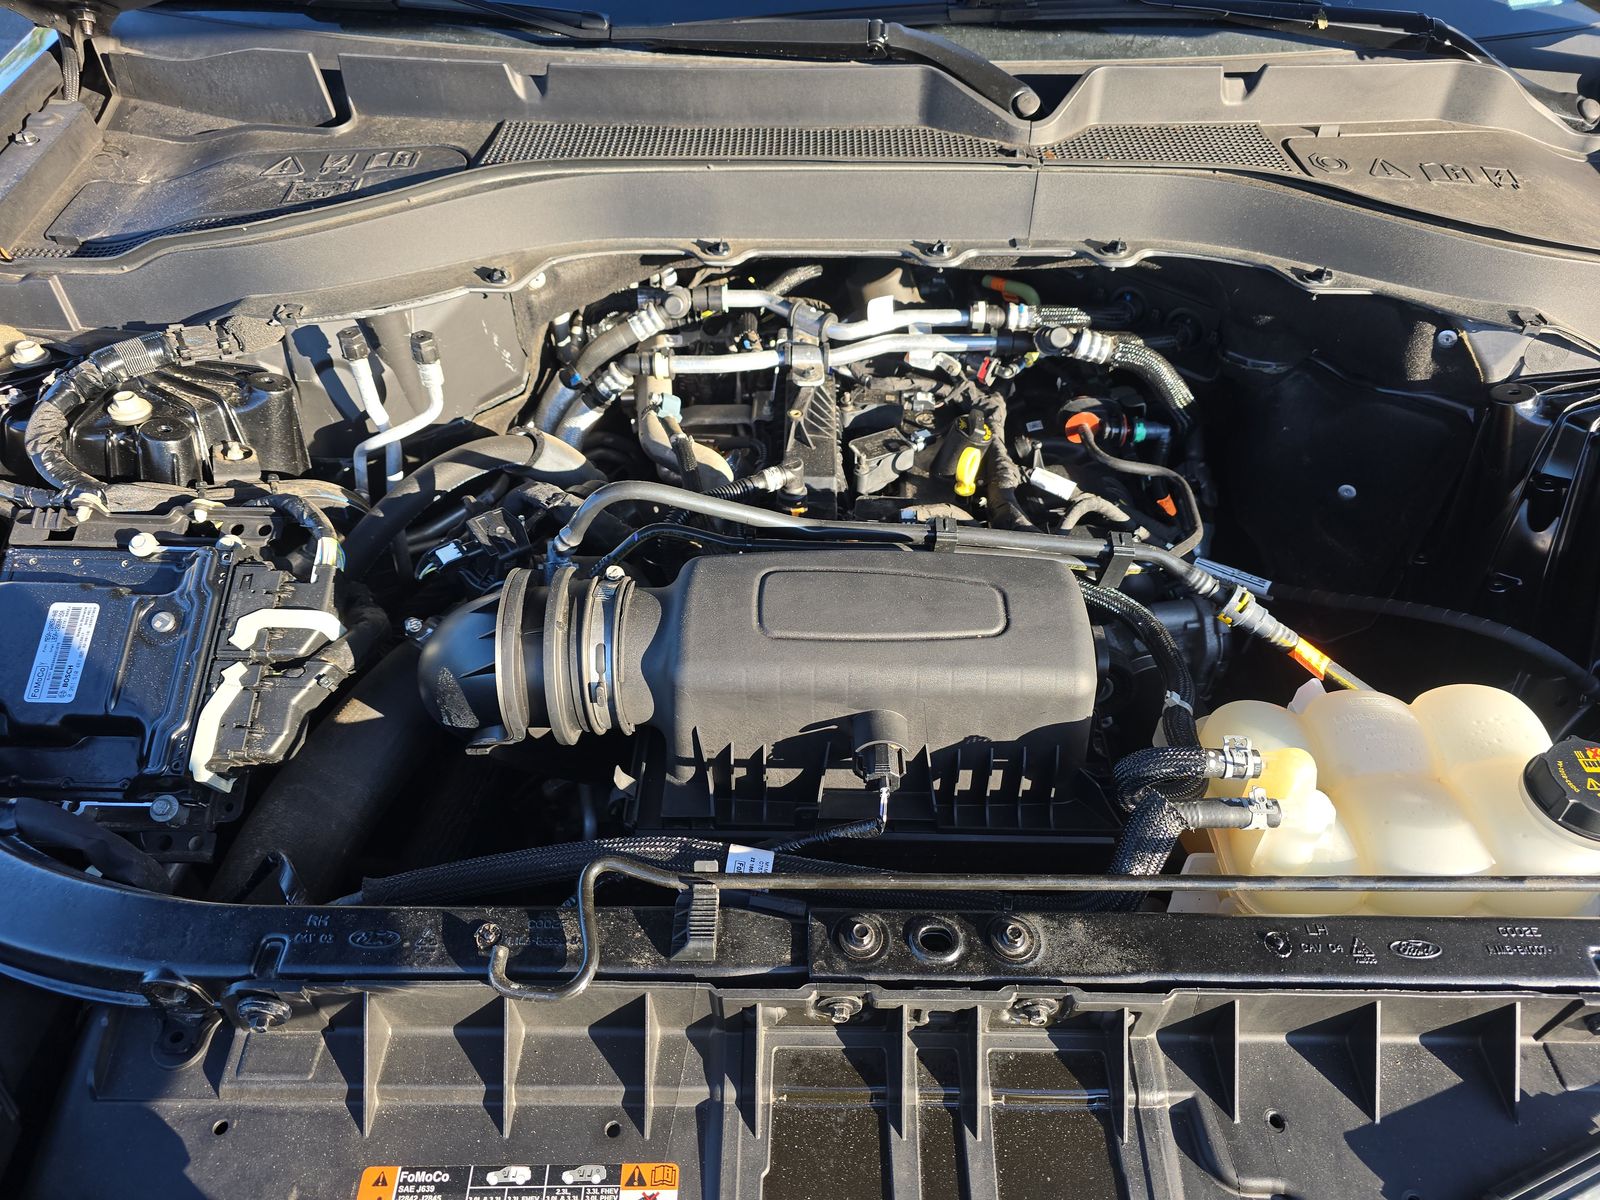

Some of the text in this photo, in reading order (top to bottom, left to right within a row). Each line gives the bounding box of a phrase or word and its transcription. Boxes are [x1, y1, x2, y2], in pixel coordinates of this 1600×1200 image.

[31, 667, 46, 698] FoMoCo
[62, 665, 73, 688] BOSCH
[400, 1170, 450, 1183] FoMoCo
[398, 1185, 435, 1193] SAE J639
